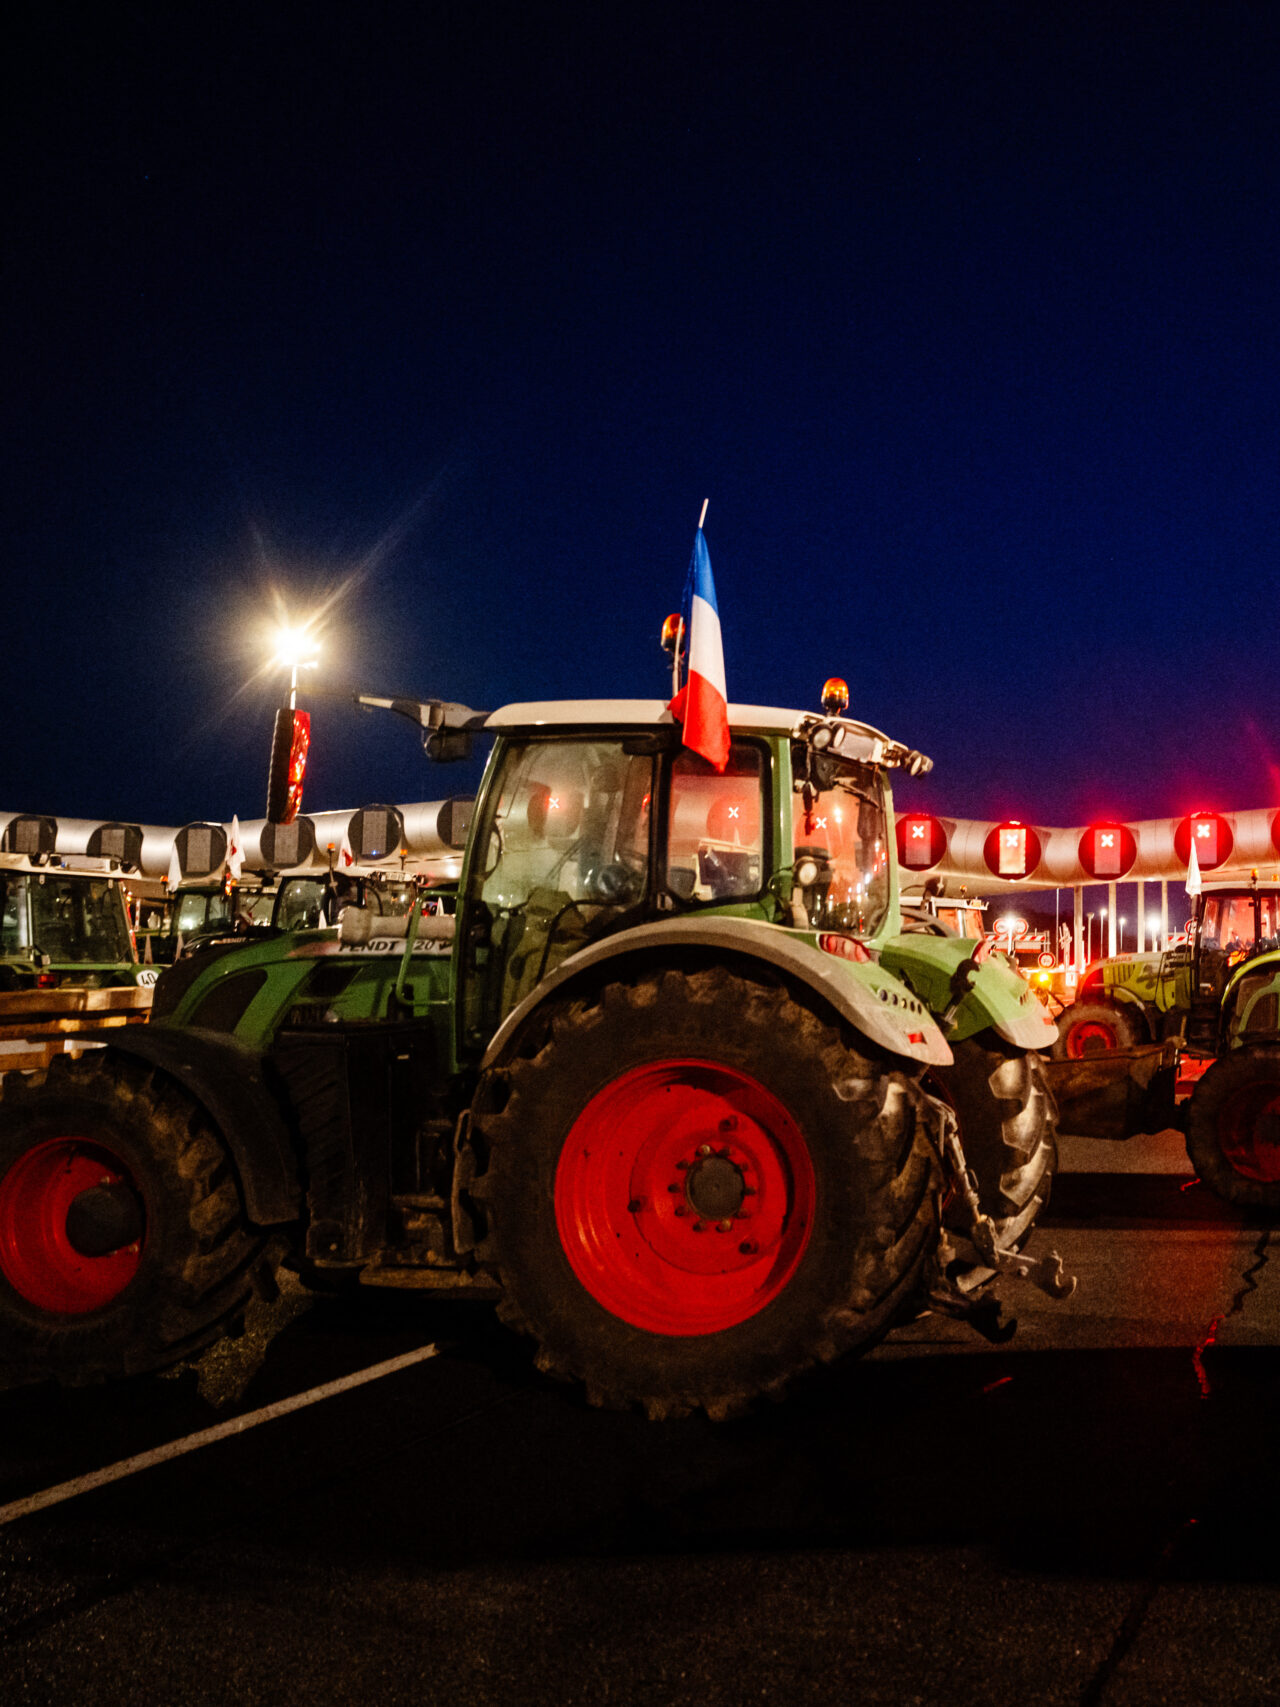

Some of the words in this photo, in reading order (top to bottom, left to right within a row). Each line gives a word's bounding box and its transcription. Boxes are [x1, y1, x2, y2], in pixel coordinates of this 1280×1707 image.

[338, 940, 400, 952] FENDT
[410, 939, 435, 950] 20
[141, 973, 157, 986] 40
